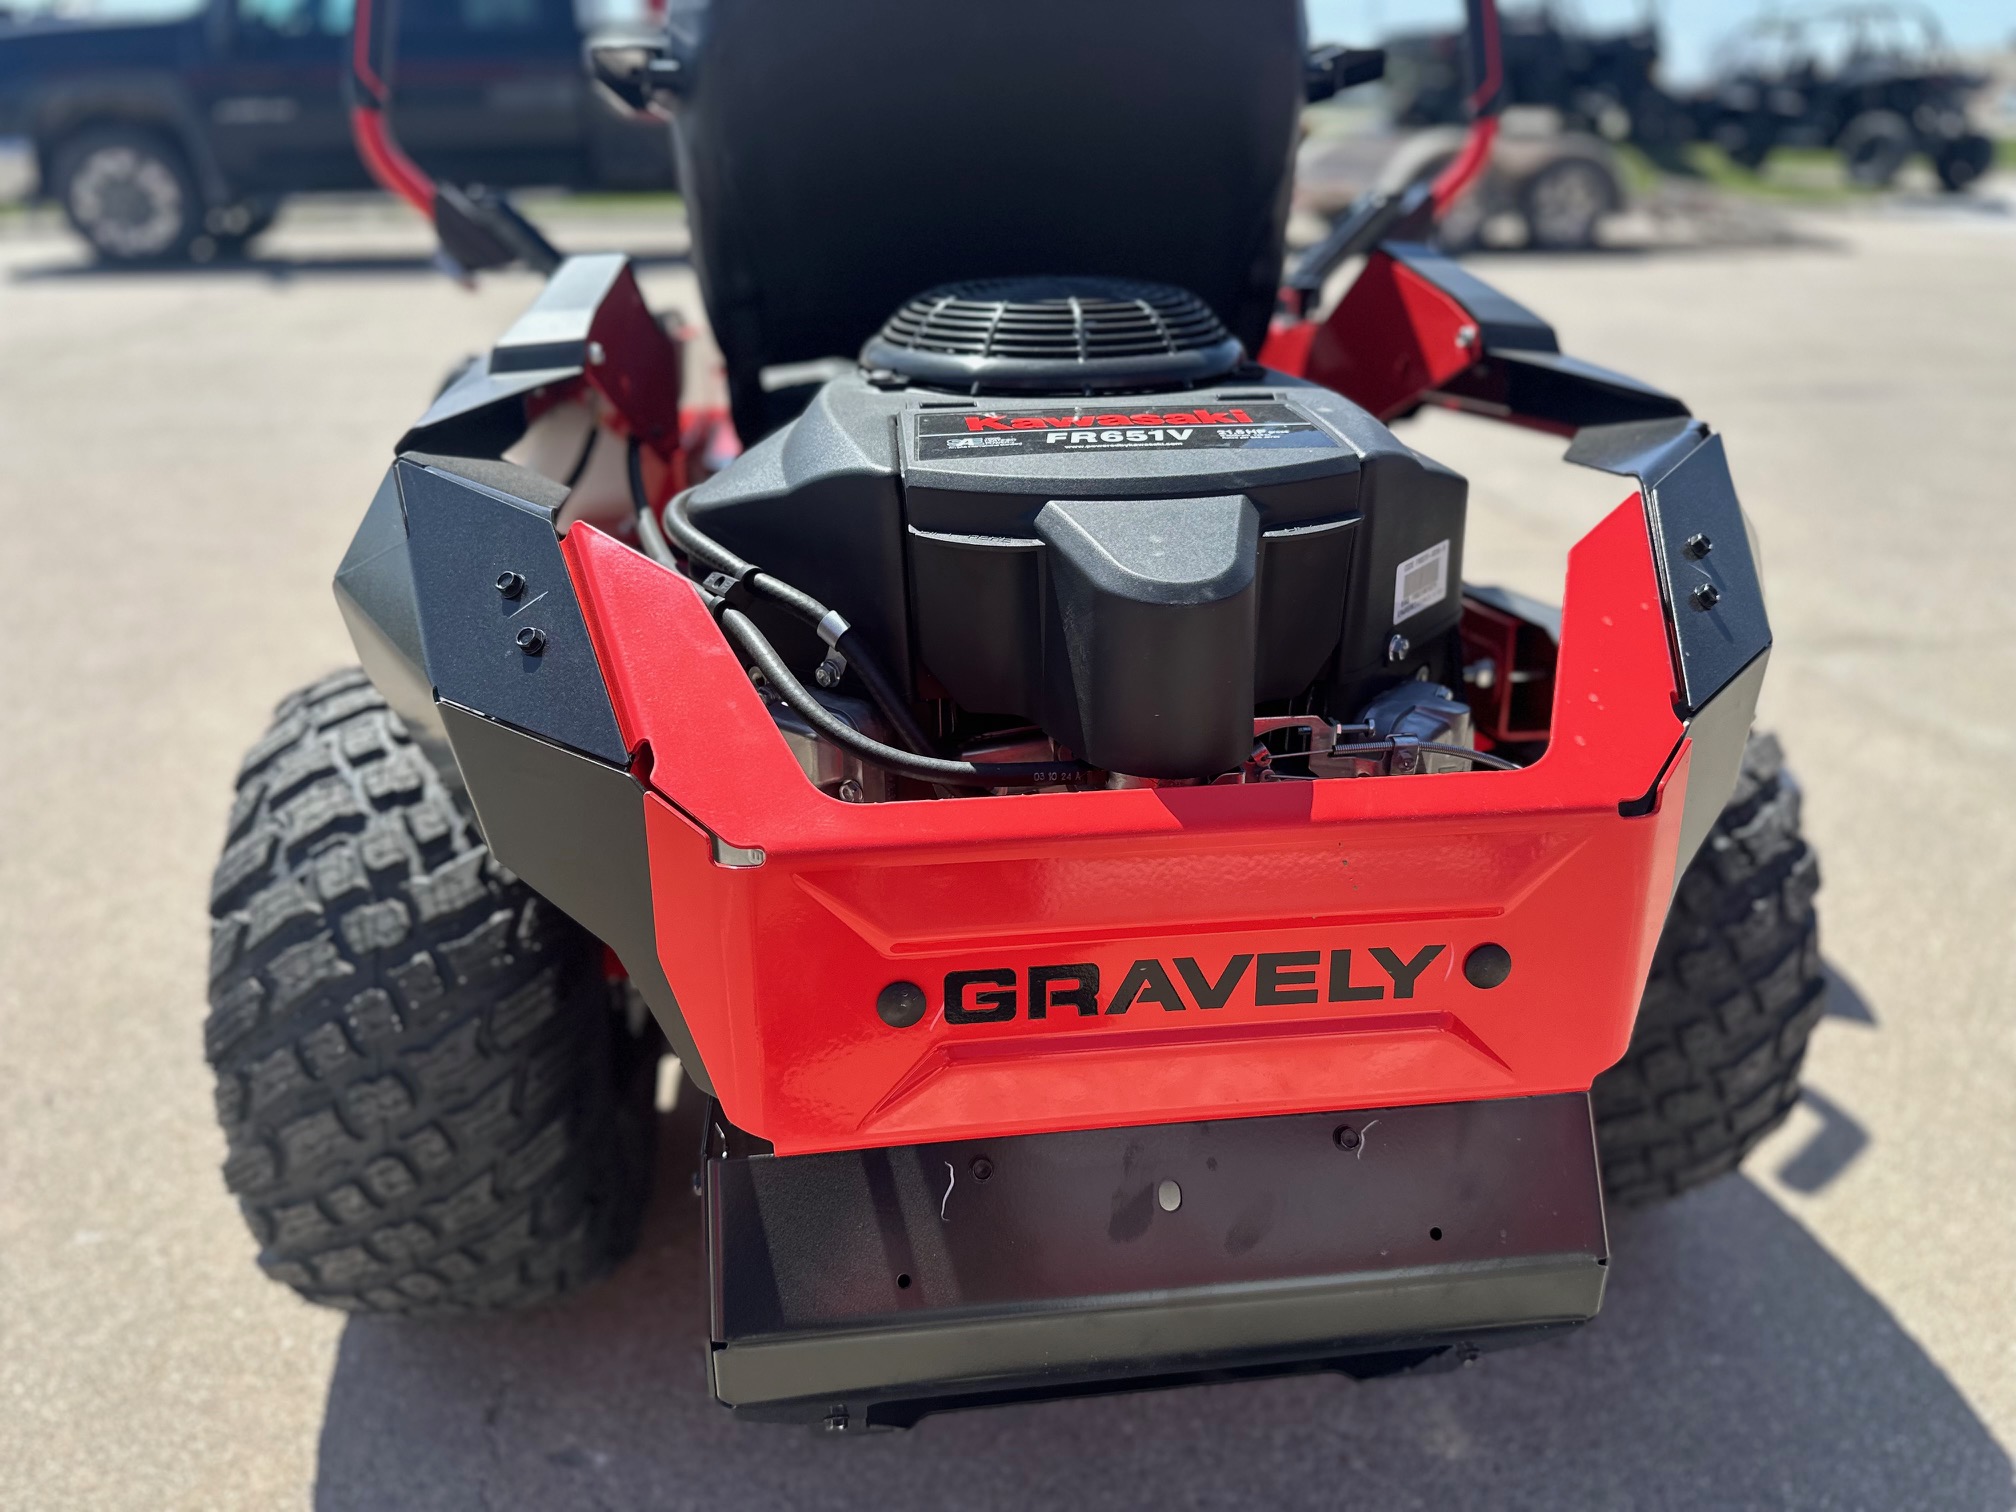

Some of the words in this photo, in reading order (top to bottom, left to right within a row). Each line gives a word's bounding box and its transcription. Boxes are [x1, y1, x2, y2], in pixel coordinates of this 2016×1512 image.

[964, 409, 1254, 431] Kawasaki
[1046, 429, 1193, 444] FR651V
[1033, 772, 1045, 782] 03
[1061, 772, 1072, 780] 24
[943, 944, 1447, 1025] GRAVELY
